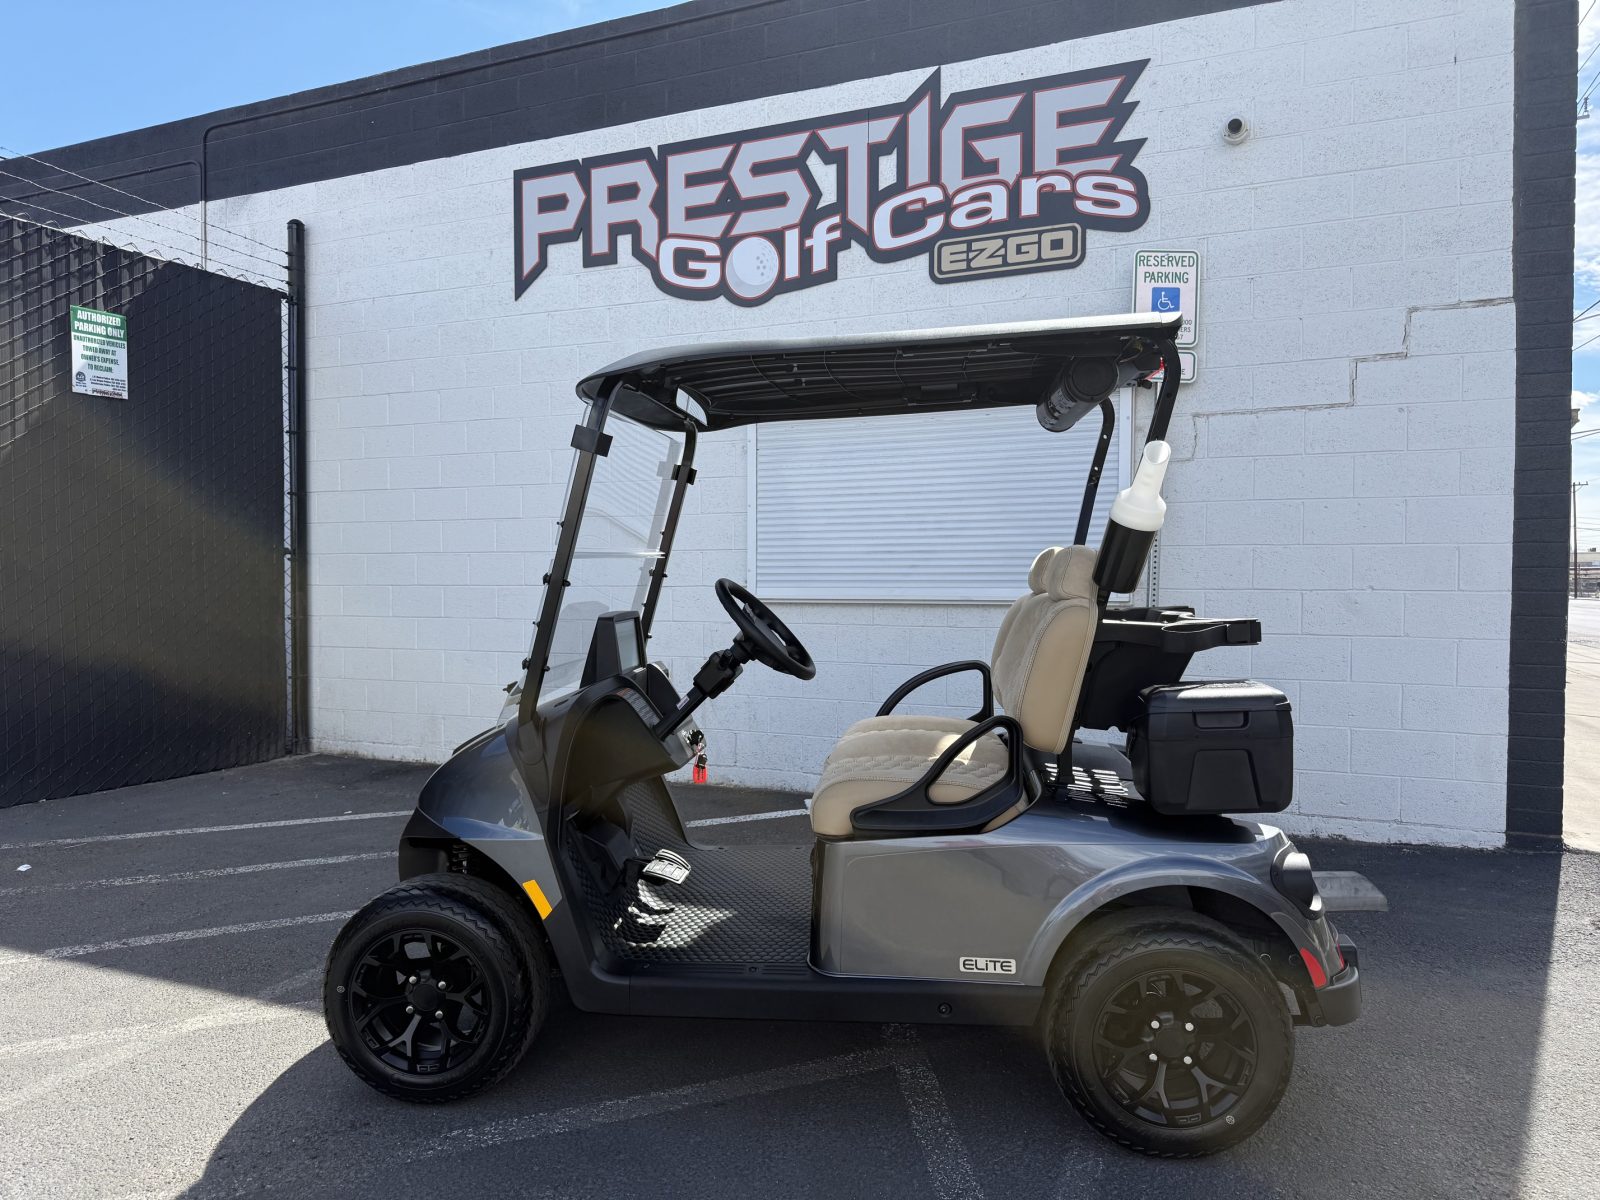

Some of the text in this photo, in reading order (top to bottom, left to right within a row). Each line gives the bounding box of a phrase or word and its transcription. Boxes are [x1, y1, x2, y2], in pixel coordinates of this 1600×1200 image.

[521, 75, 1126, 280] PRESTIGE
[659, 171, 1139, 298] Golf Cars
[1138, 255, 1196, 268] RESERVED
[1143, 271, 1189, 284] PARKING
[77, 310, 121, 327] AUTHORIZED
[74, 321, 125, 339] PARKING ONLY
[73, 335, 126, 350] UNAUTHORIZED VEHICLES
[82, 345, 98, 353] TOWED
[81, 353, 100, 362] OWNER'S
[87, 363, 94, 371] TO
